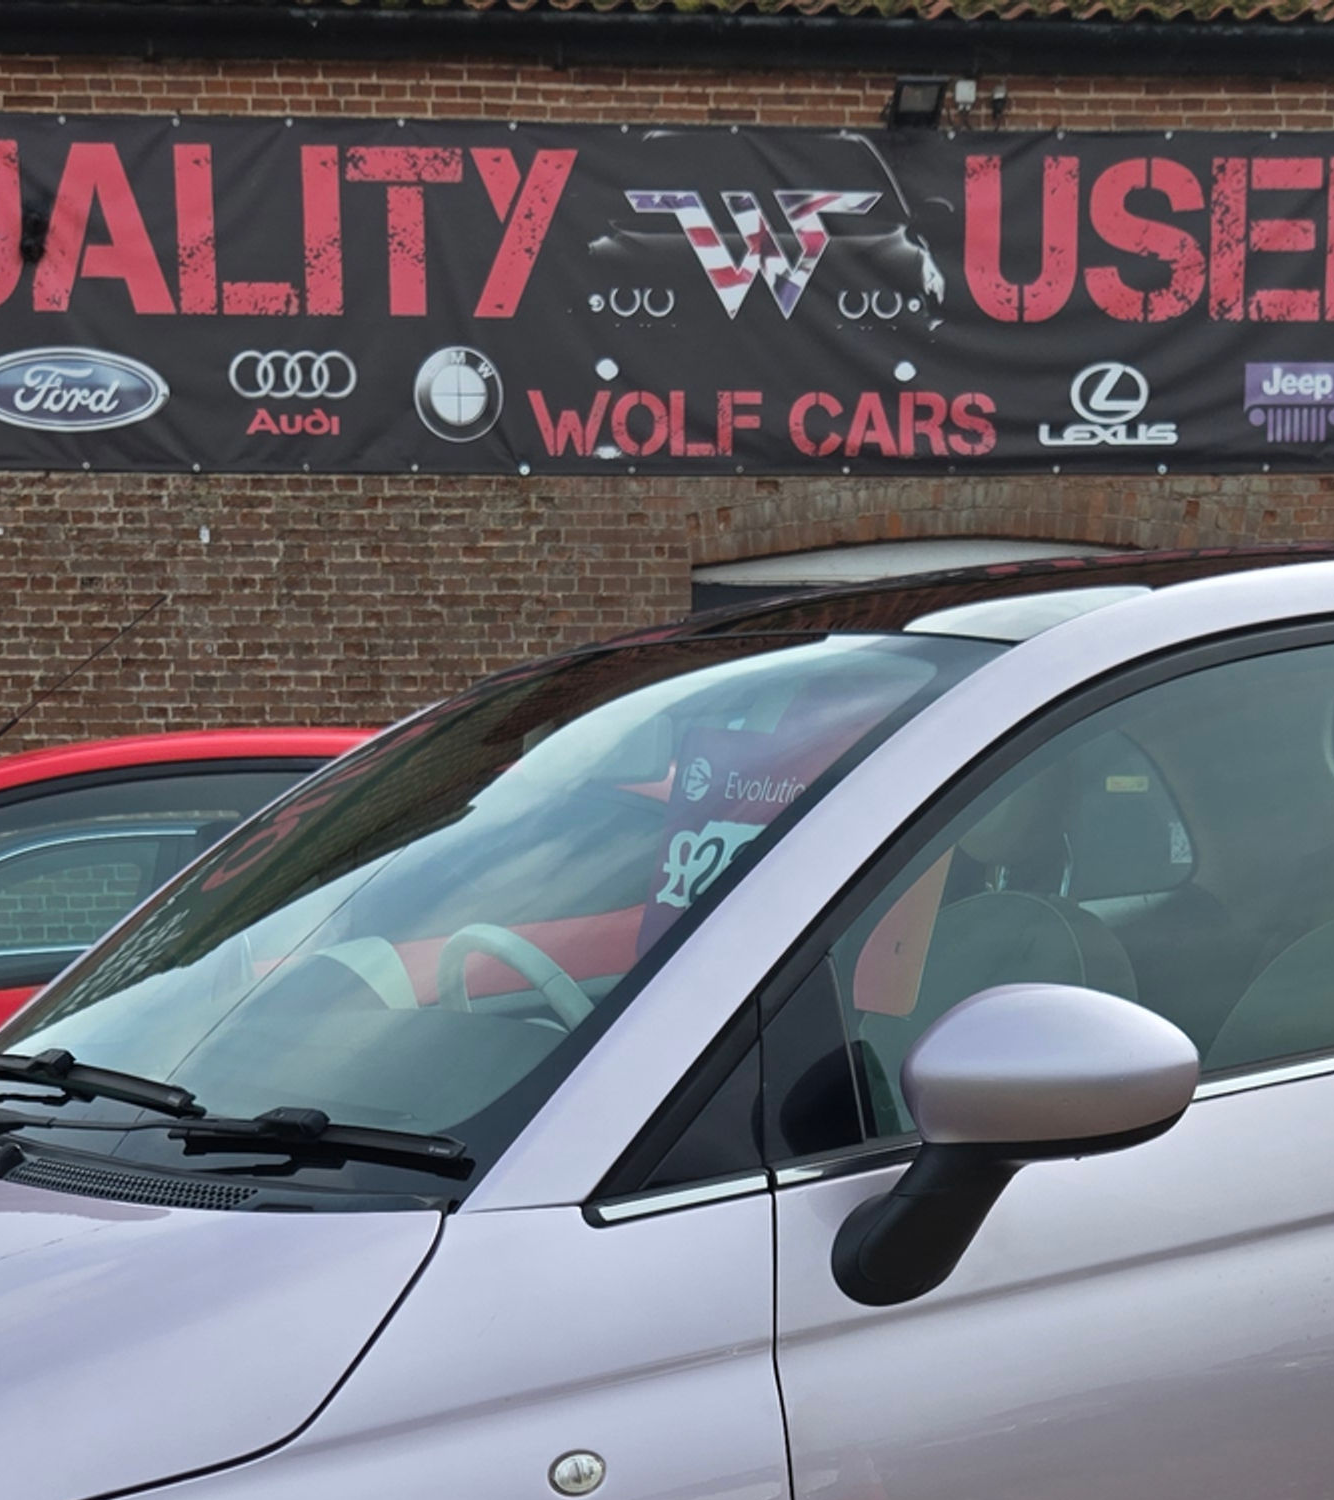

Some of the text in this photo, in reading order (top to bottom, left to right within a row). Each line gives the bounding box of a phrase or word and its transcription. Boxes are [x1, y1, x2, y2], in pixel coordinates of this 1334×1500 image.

[14, 364, 120, 414] Ford
[1262, 367, 1334, 401] Jeep
[246, 407, 341, 436] Audi
[527, 389, 998, 457] WOLF CARS
[1038, 422, 1179, 446] LEXUS
[655, 827, 757, 909] £2
